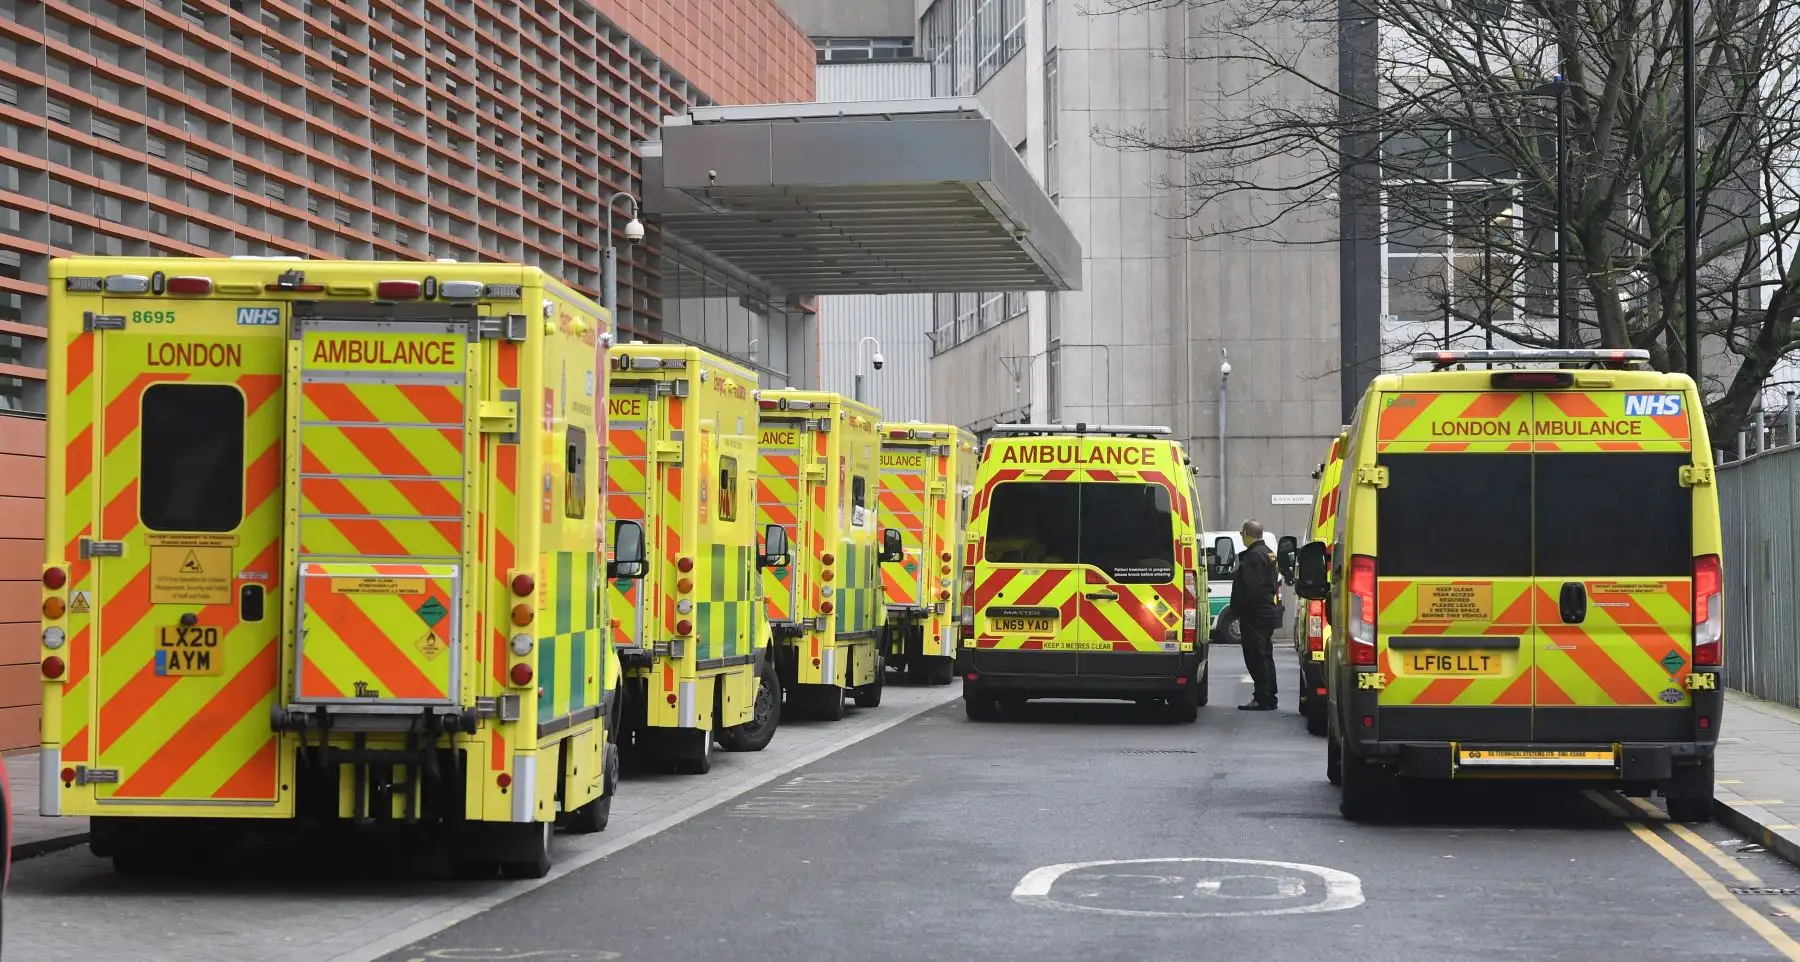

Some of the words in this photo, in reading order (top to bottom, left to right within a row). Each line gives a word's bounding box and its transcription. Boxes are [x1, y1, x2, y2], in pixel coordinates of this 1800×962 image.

[132, 311, 175, 324] 8695
[238, 308, 279, 325] NHS
[147, 342, 242, 367] LONDON
[312, 339, 456, 365] AMBULANCE
[1625, 394, 1680, 416] NHS
[1431, 421, 1511, 436] LONDON
[879, 455, 922, 467] BULANCE
[1002, 445, 1156, 465] AMBULANCE
[995, 620, 1024, 630] LN69
[1027, 620, 1049, 630] YAO
[161, 627, 217, 647] LX20
[168, 650, 210, 670] AYM
[1414, 655, 1452, 671] LF16
[1457, 655, 1490, 671] LLT
